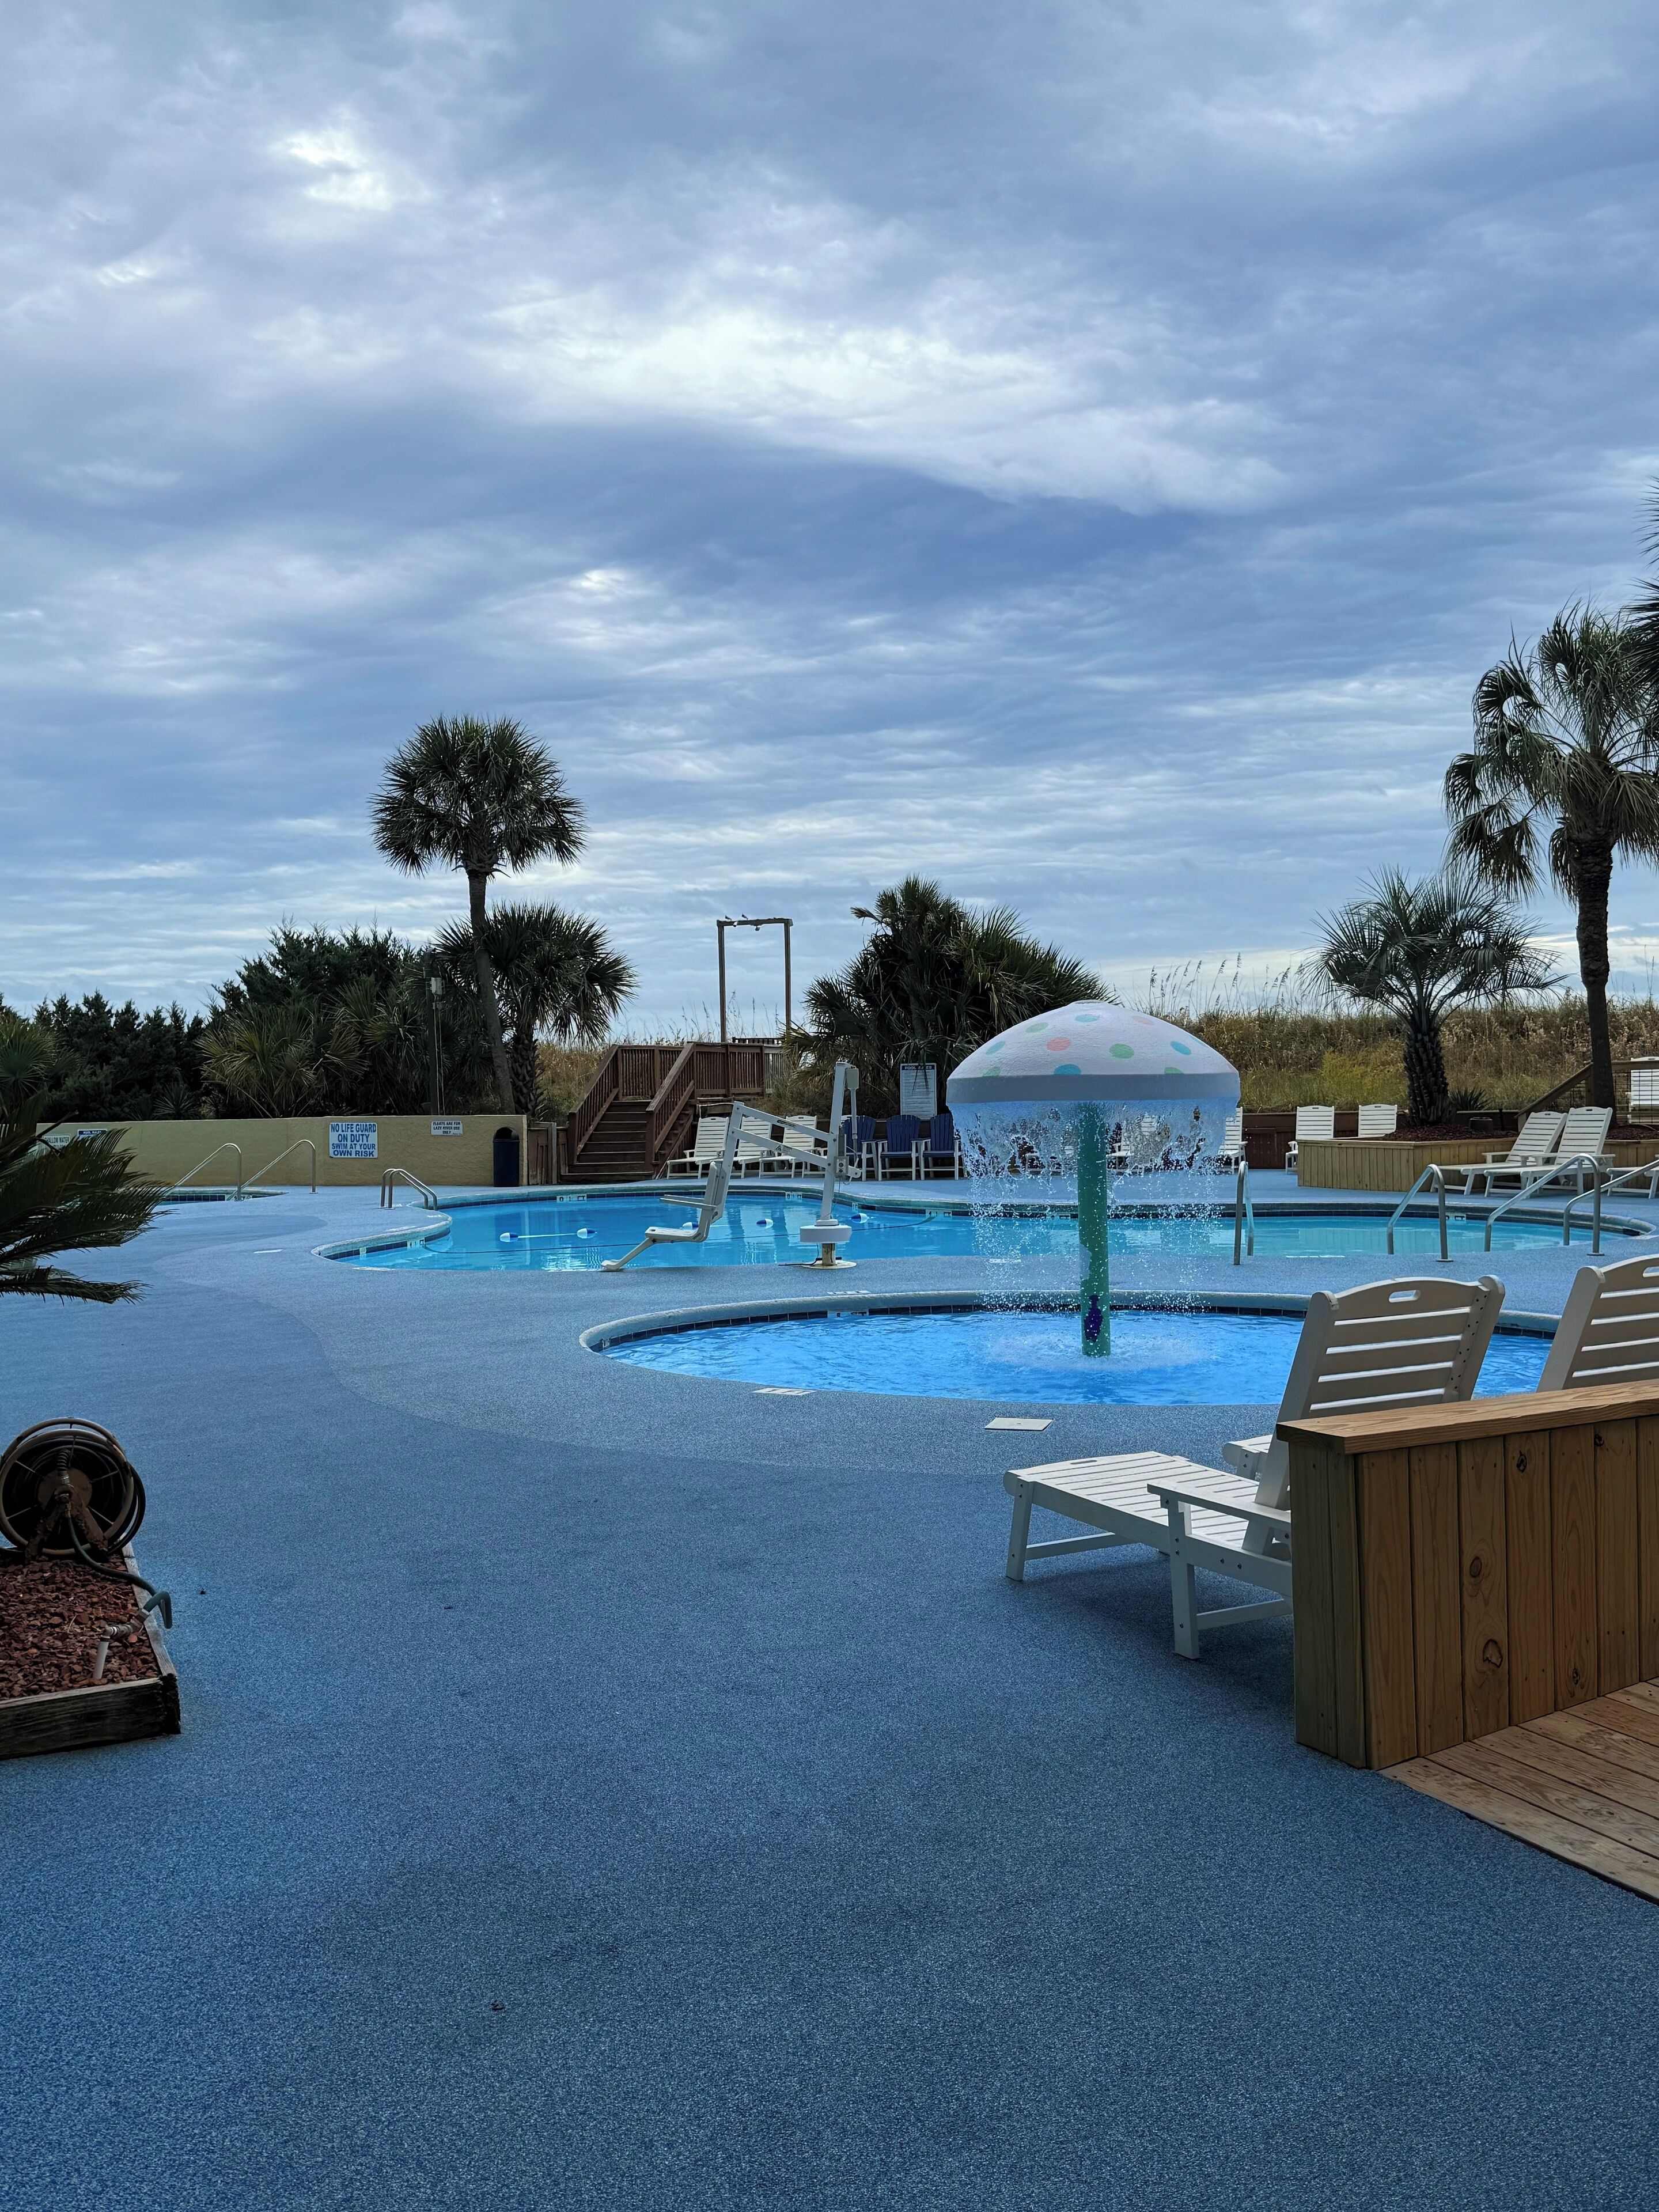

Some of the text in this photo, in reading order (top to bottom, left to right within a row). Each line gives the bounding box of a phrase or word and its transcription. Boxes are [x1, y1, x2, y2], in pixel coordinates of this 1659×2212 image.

[331, 1123, 376, 1132] NO LIFE GUARD
[338, 1134, 370, 1142] ON DUTY
